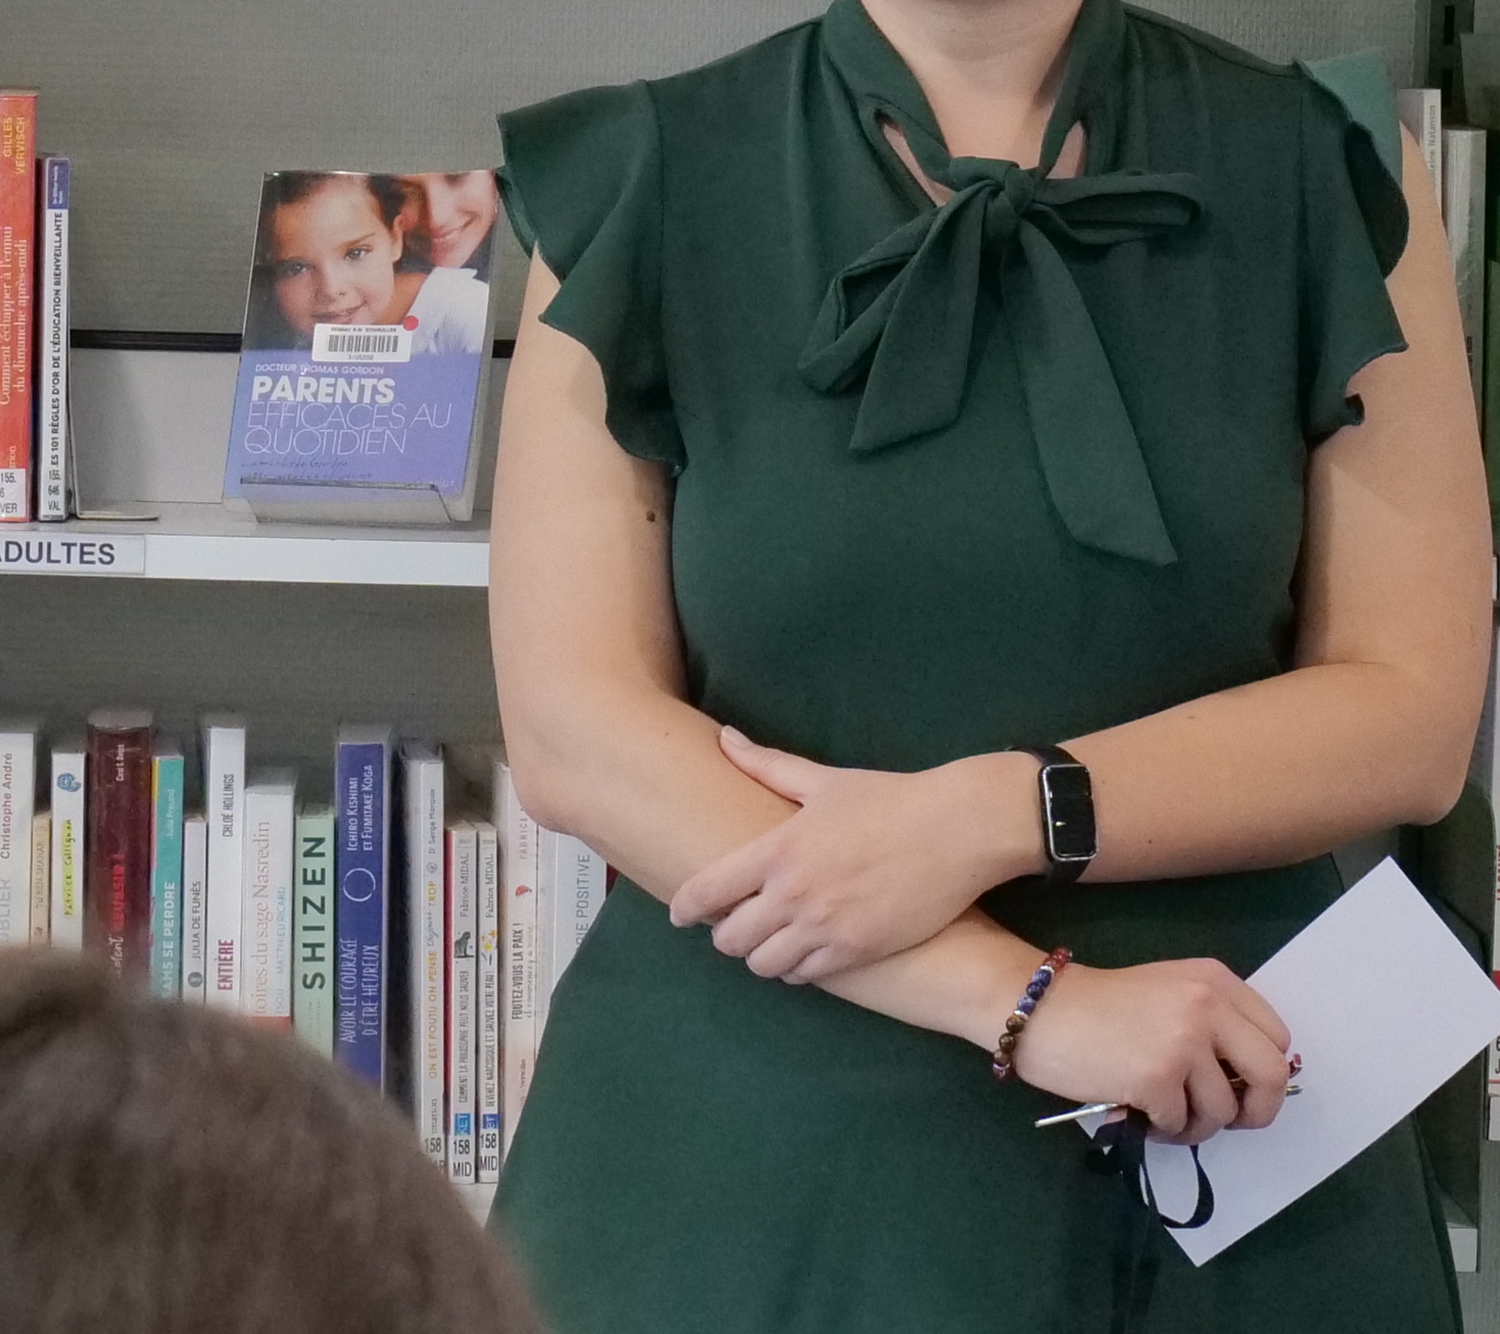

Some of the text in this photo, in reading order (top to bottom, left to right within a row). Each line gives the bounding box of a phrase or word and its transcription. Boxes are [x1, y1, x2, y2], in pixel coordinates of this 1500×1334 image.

[255, 364, 297, 372] DOCTEUR
[341, 366, 384, 374] GORDON
[251, 375, 396, 404] PARENTS
[247, 401, 452, 430] EFFICACES AU
[244, 428, 407, 455] QUOTIDIEN
[302, 835, 326, 991] SHIZEN
[217, 939, 234, 991] ENTIÈRE
[452, 1140, 471, 1155] 158
[452, 1161, 472, 1177] MID
